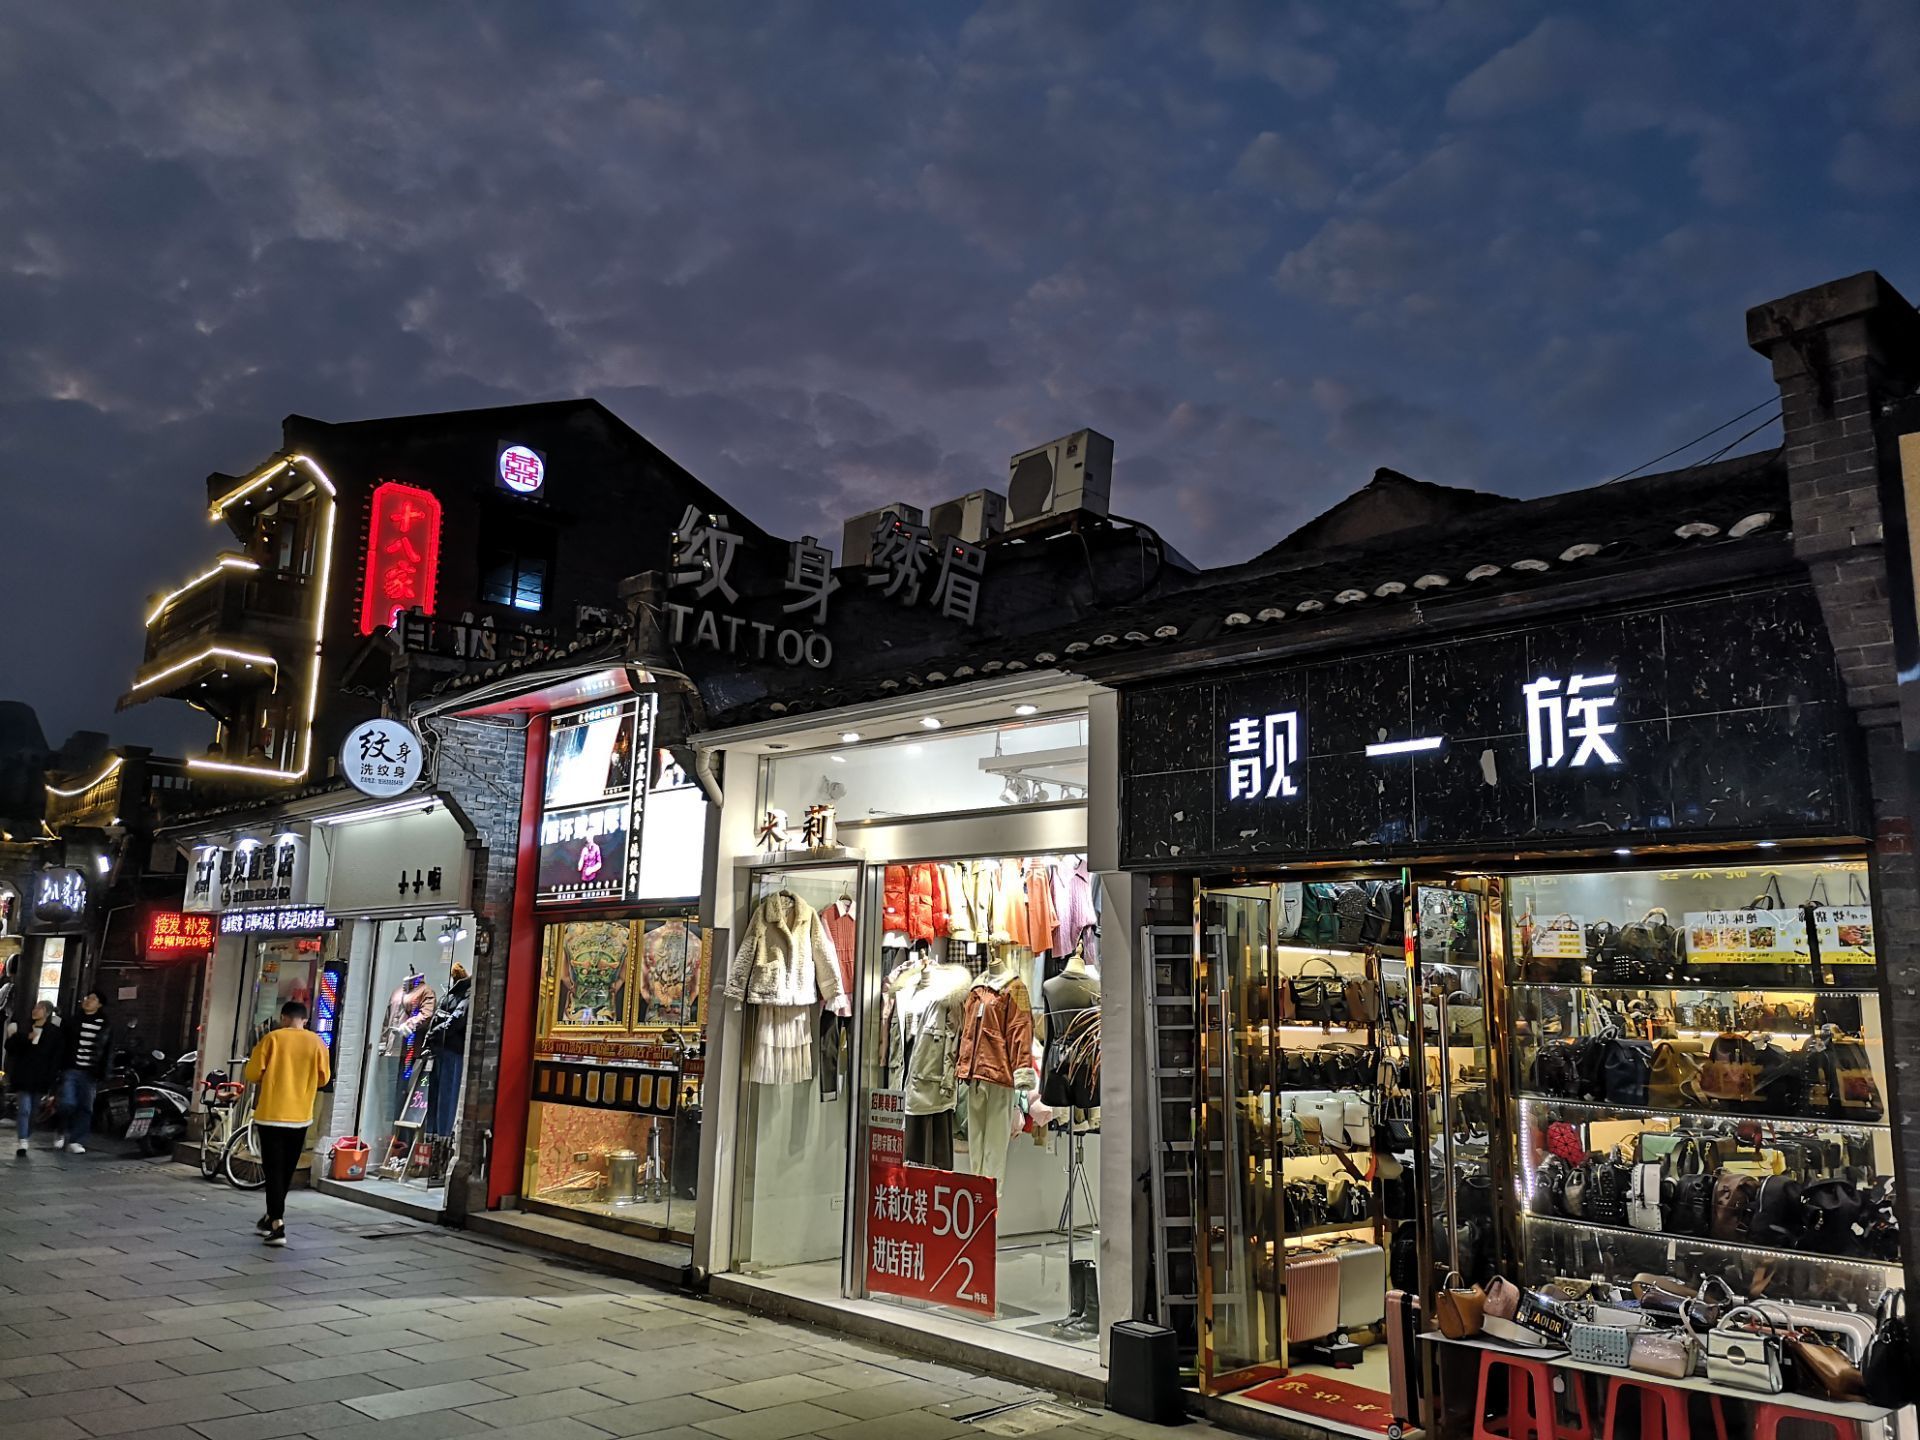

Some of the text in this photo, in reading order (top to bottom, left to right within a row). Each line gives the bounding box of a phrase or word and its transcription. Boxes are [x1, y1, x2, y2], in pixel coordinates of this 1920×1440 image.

[669, 504, 987, 626] 纹身绣眉
[664, 604, 833, 668] TATTOO
[359, 729, 411, 764] 纹身
[1228, 674, 1623, 800] 靓一族
[360, 763, 406, 778] 洗纹身
[874, 1184, 928, 1226] 米莉女装
[872, 1235, 925, 1281] 进店有礼
